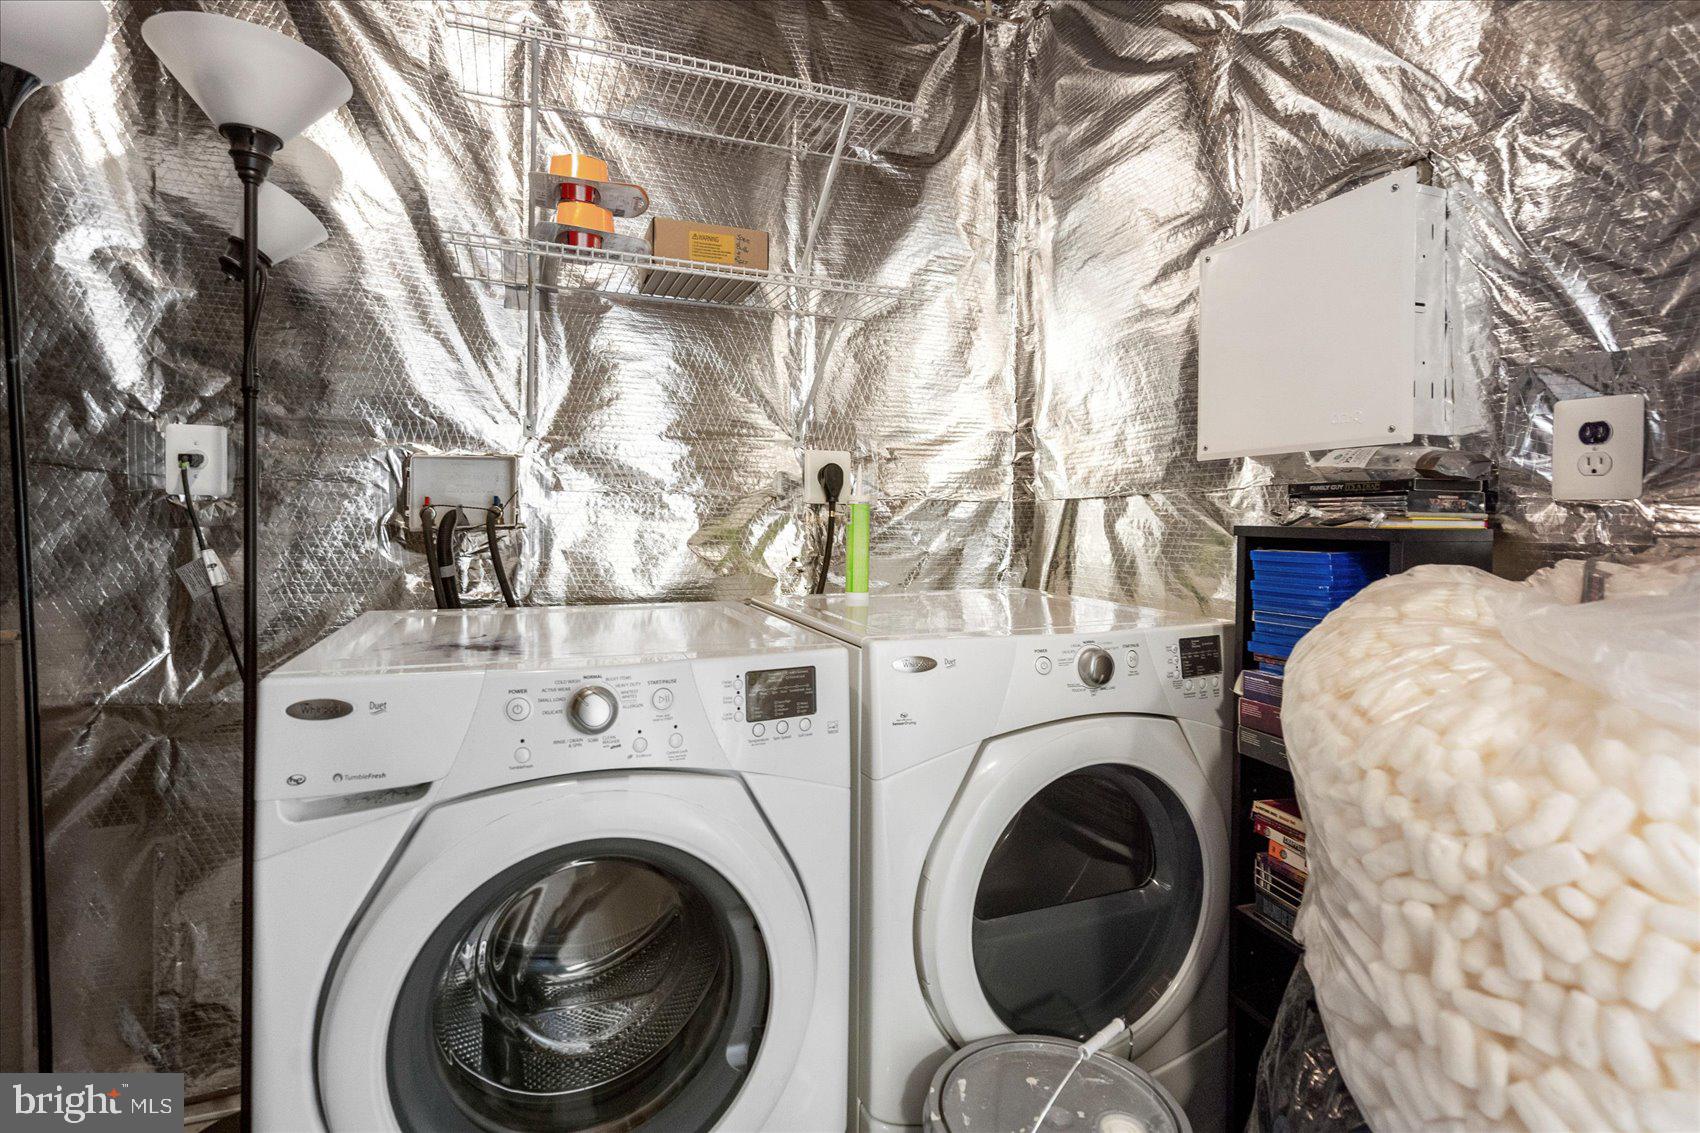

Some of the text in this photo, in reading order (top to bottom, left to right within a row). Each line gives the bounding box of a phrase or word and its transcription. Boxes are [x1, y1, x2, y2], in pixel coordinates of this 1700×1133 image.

[699, 235, 720, 243] WARNING
[369, 701, 387, 710] Duet
[344, 772, 387, 781] TumbleFresh
